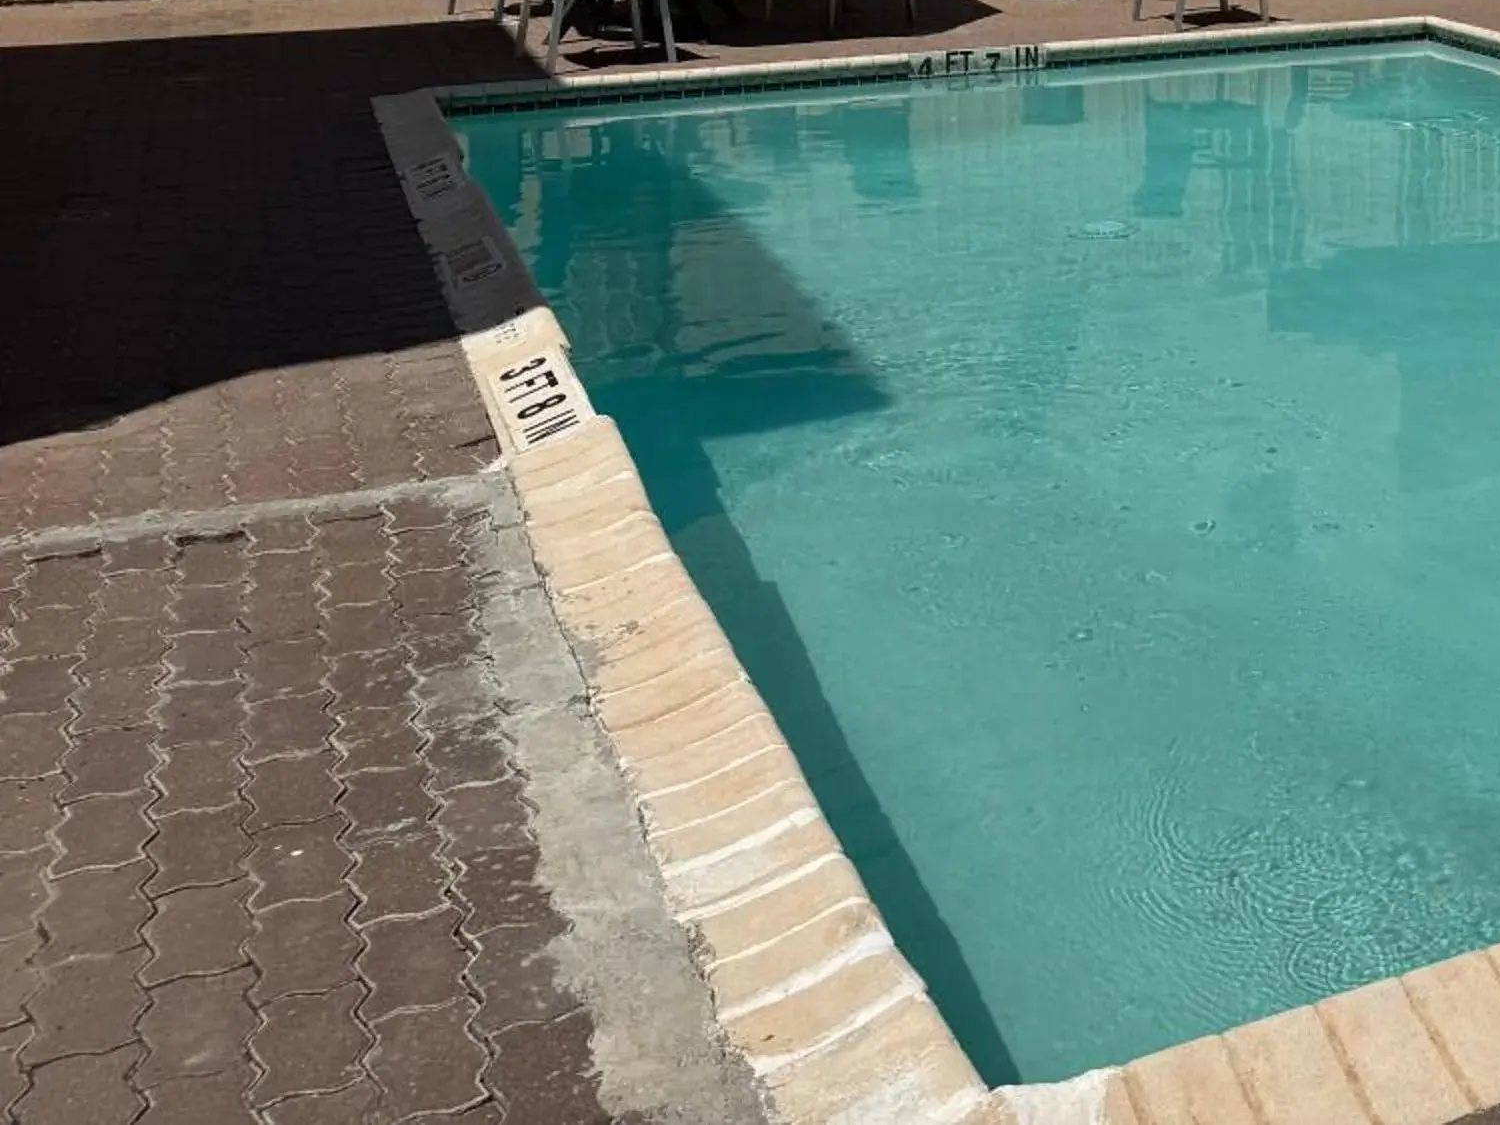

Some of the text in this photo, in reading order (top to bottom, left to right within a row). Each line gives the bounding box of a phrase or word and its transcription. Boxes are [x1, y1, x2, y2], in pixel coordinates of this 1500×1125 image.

[918, 46, 1039, 76] 4 FT 7 IN
[499, 356, 547, 382] 3
[503, 369, 559, 403] FT
[516, 392, 568, 419] 8
[522, 407, 582, 445] IN
